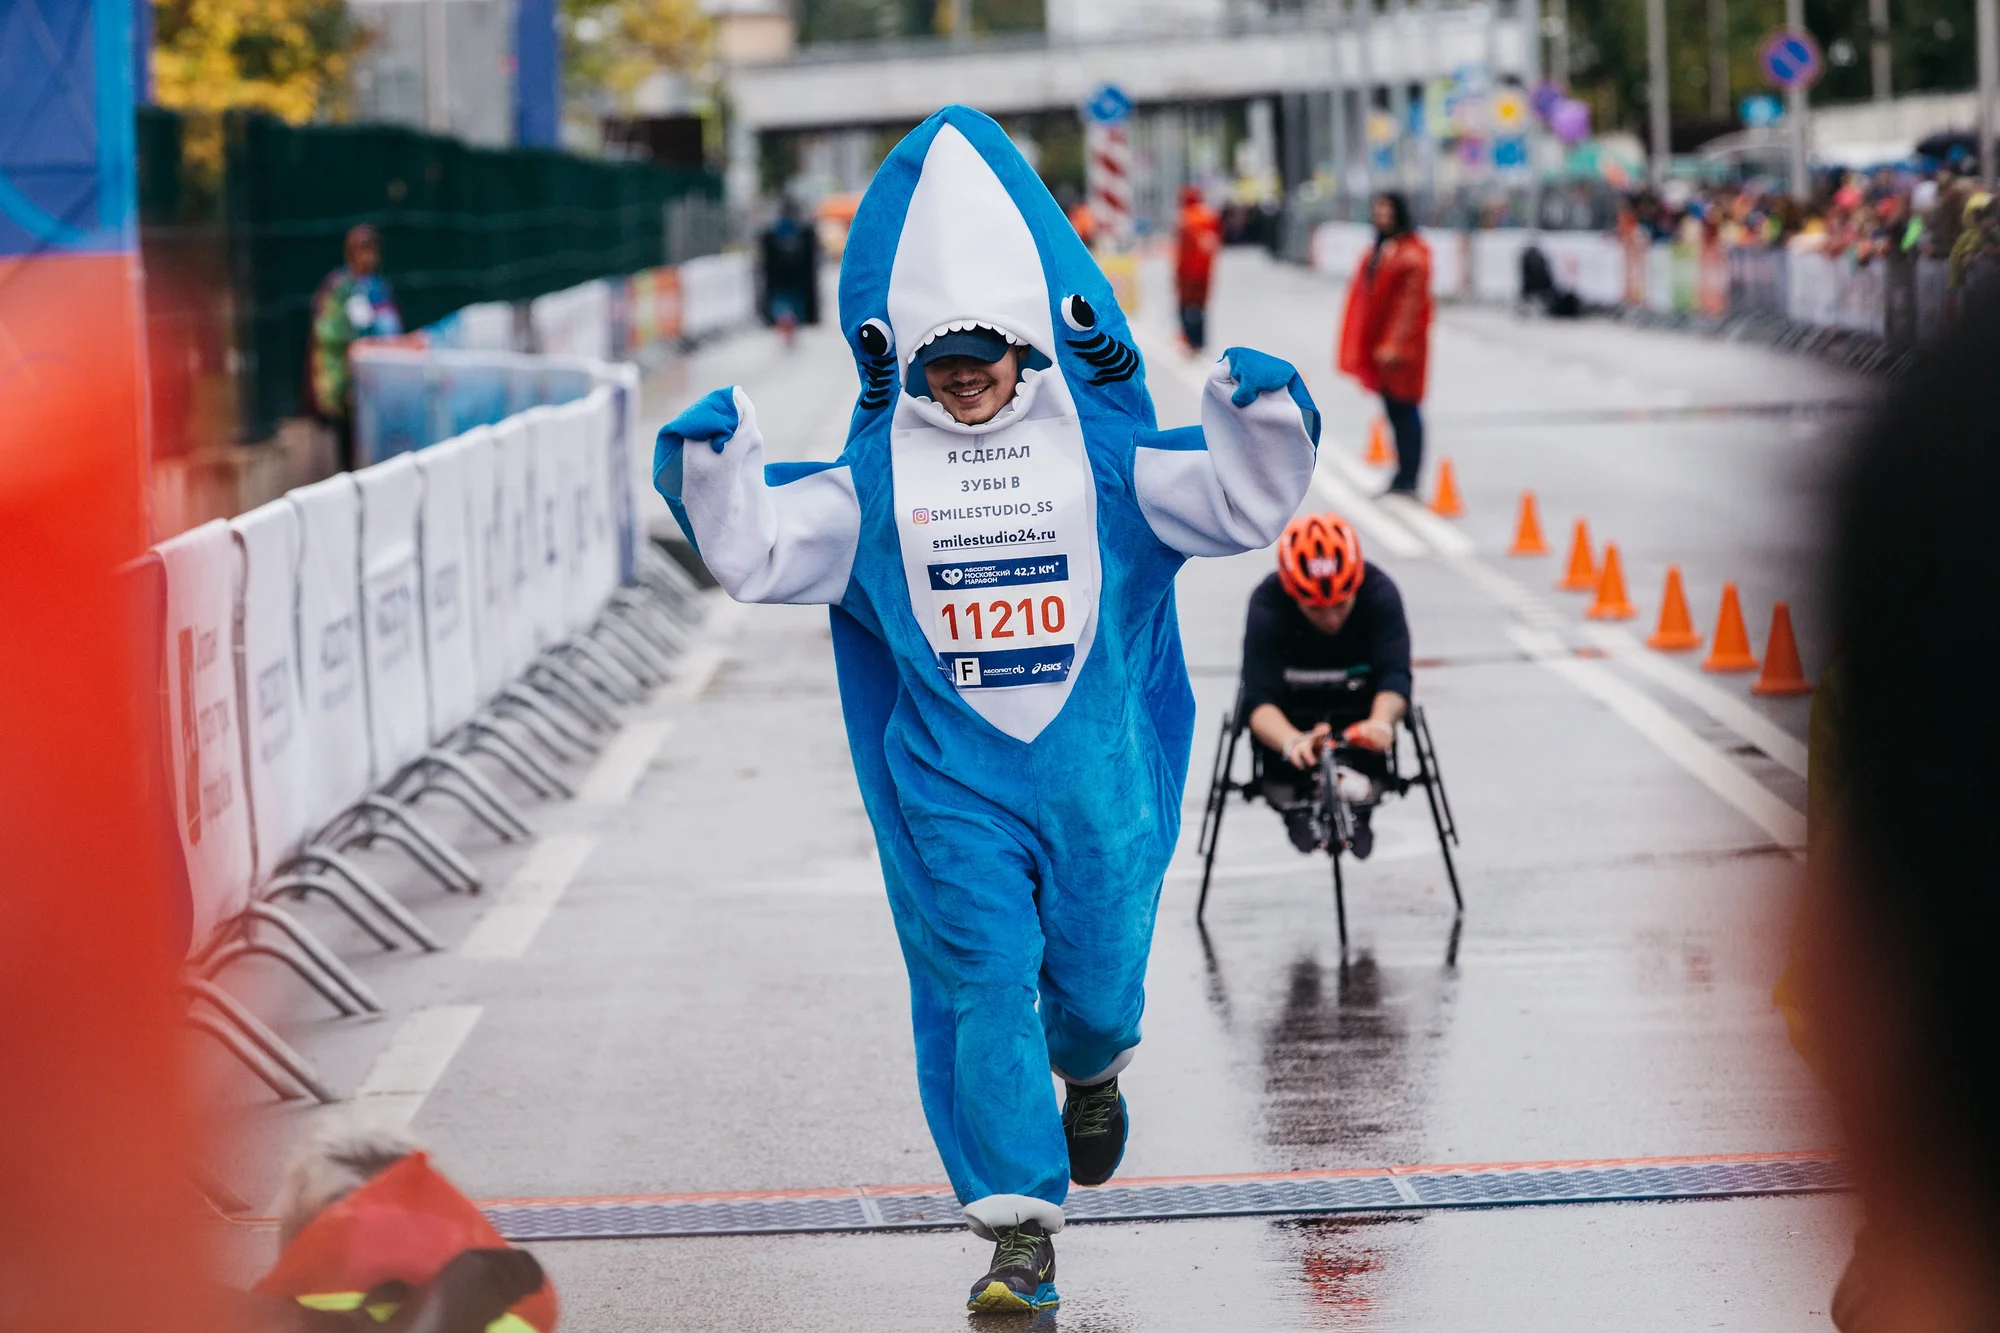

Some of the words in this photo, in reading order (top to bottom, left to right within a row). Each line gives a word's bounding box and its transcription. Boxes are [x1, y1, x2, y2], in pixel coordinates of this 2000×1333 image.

[948, 451, 957, 464] Я
[962, 445, 1030, 464] СДЕЛАЛ
[961, 477, 1006, 492] ЗУБЫ
[1012, 476, 1020, 488] В
[931, 501, 1053, 521] SMILESTUDIO_SS
[932, 528, 1056, 549] smilestudio24.ru
[964, 569, 1011, 579] МОСКОВСКИЙ
[1014, 567, 1036, 577] 42,2
[1039, 564, 1055, 575] КМ
[965, 577, 998, 585] МАРАФОН
[941, 595, 1066, 640] 11210
[961, 661, 974, 681] F
